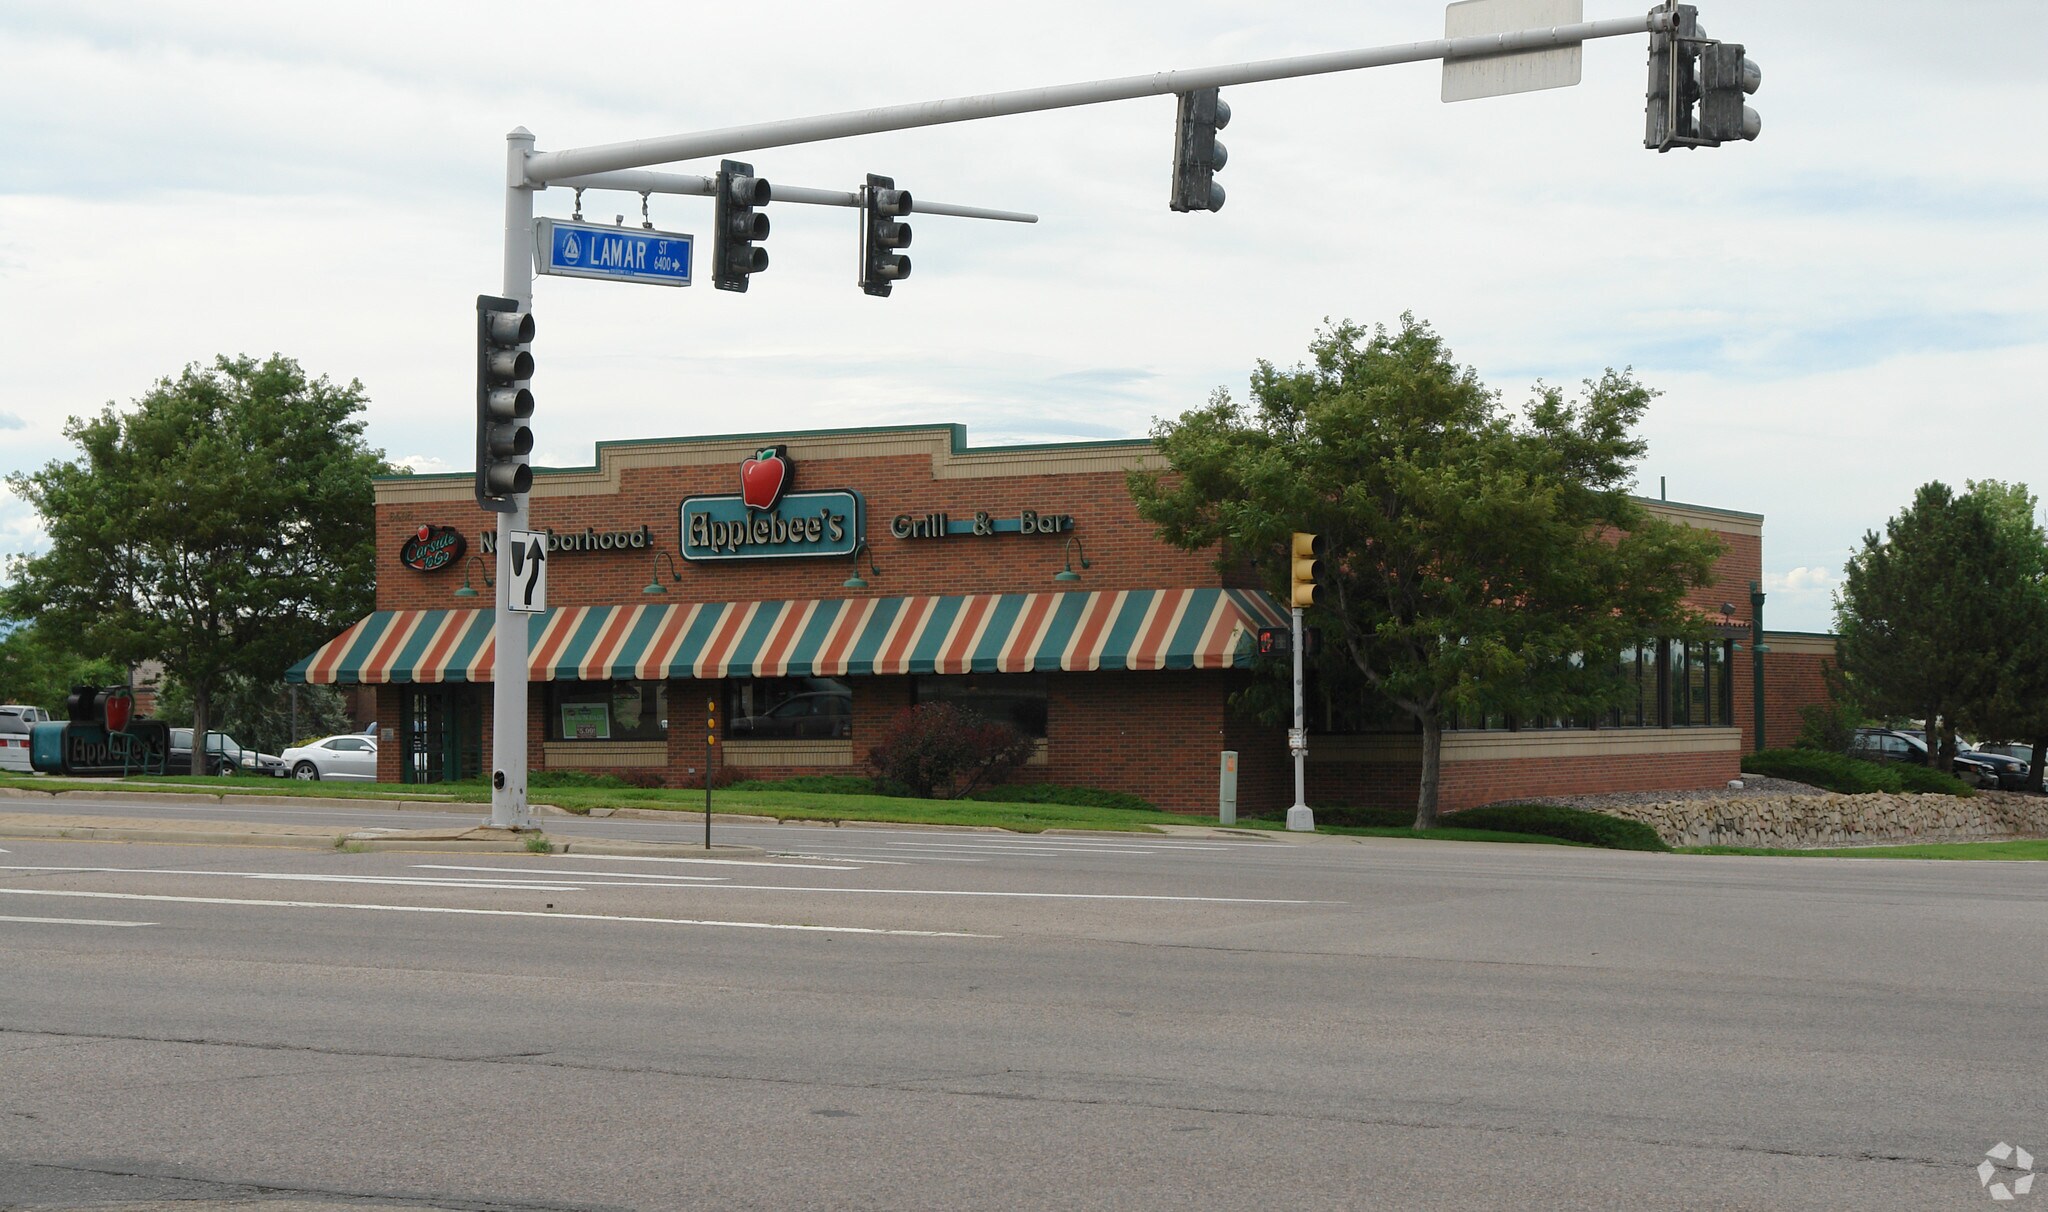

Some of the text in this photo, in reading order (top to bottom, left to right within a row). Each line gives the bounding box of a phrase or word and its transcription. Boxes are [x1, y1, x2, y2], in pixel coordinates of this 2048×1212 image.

[590, 236, 669, 270] LAMAR ST
[654, 256, 671, 271] 6400
[480, 524, 648, 553] Nborhood
[688, 508, 844, 553] Applebee's
[891, 509, 1068, 539] Grill & Bar
[406, 534, 455, 562] Carside
